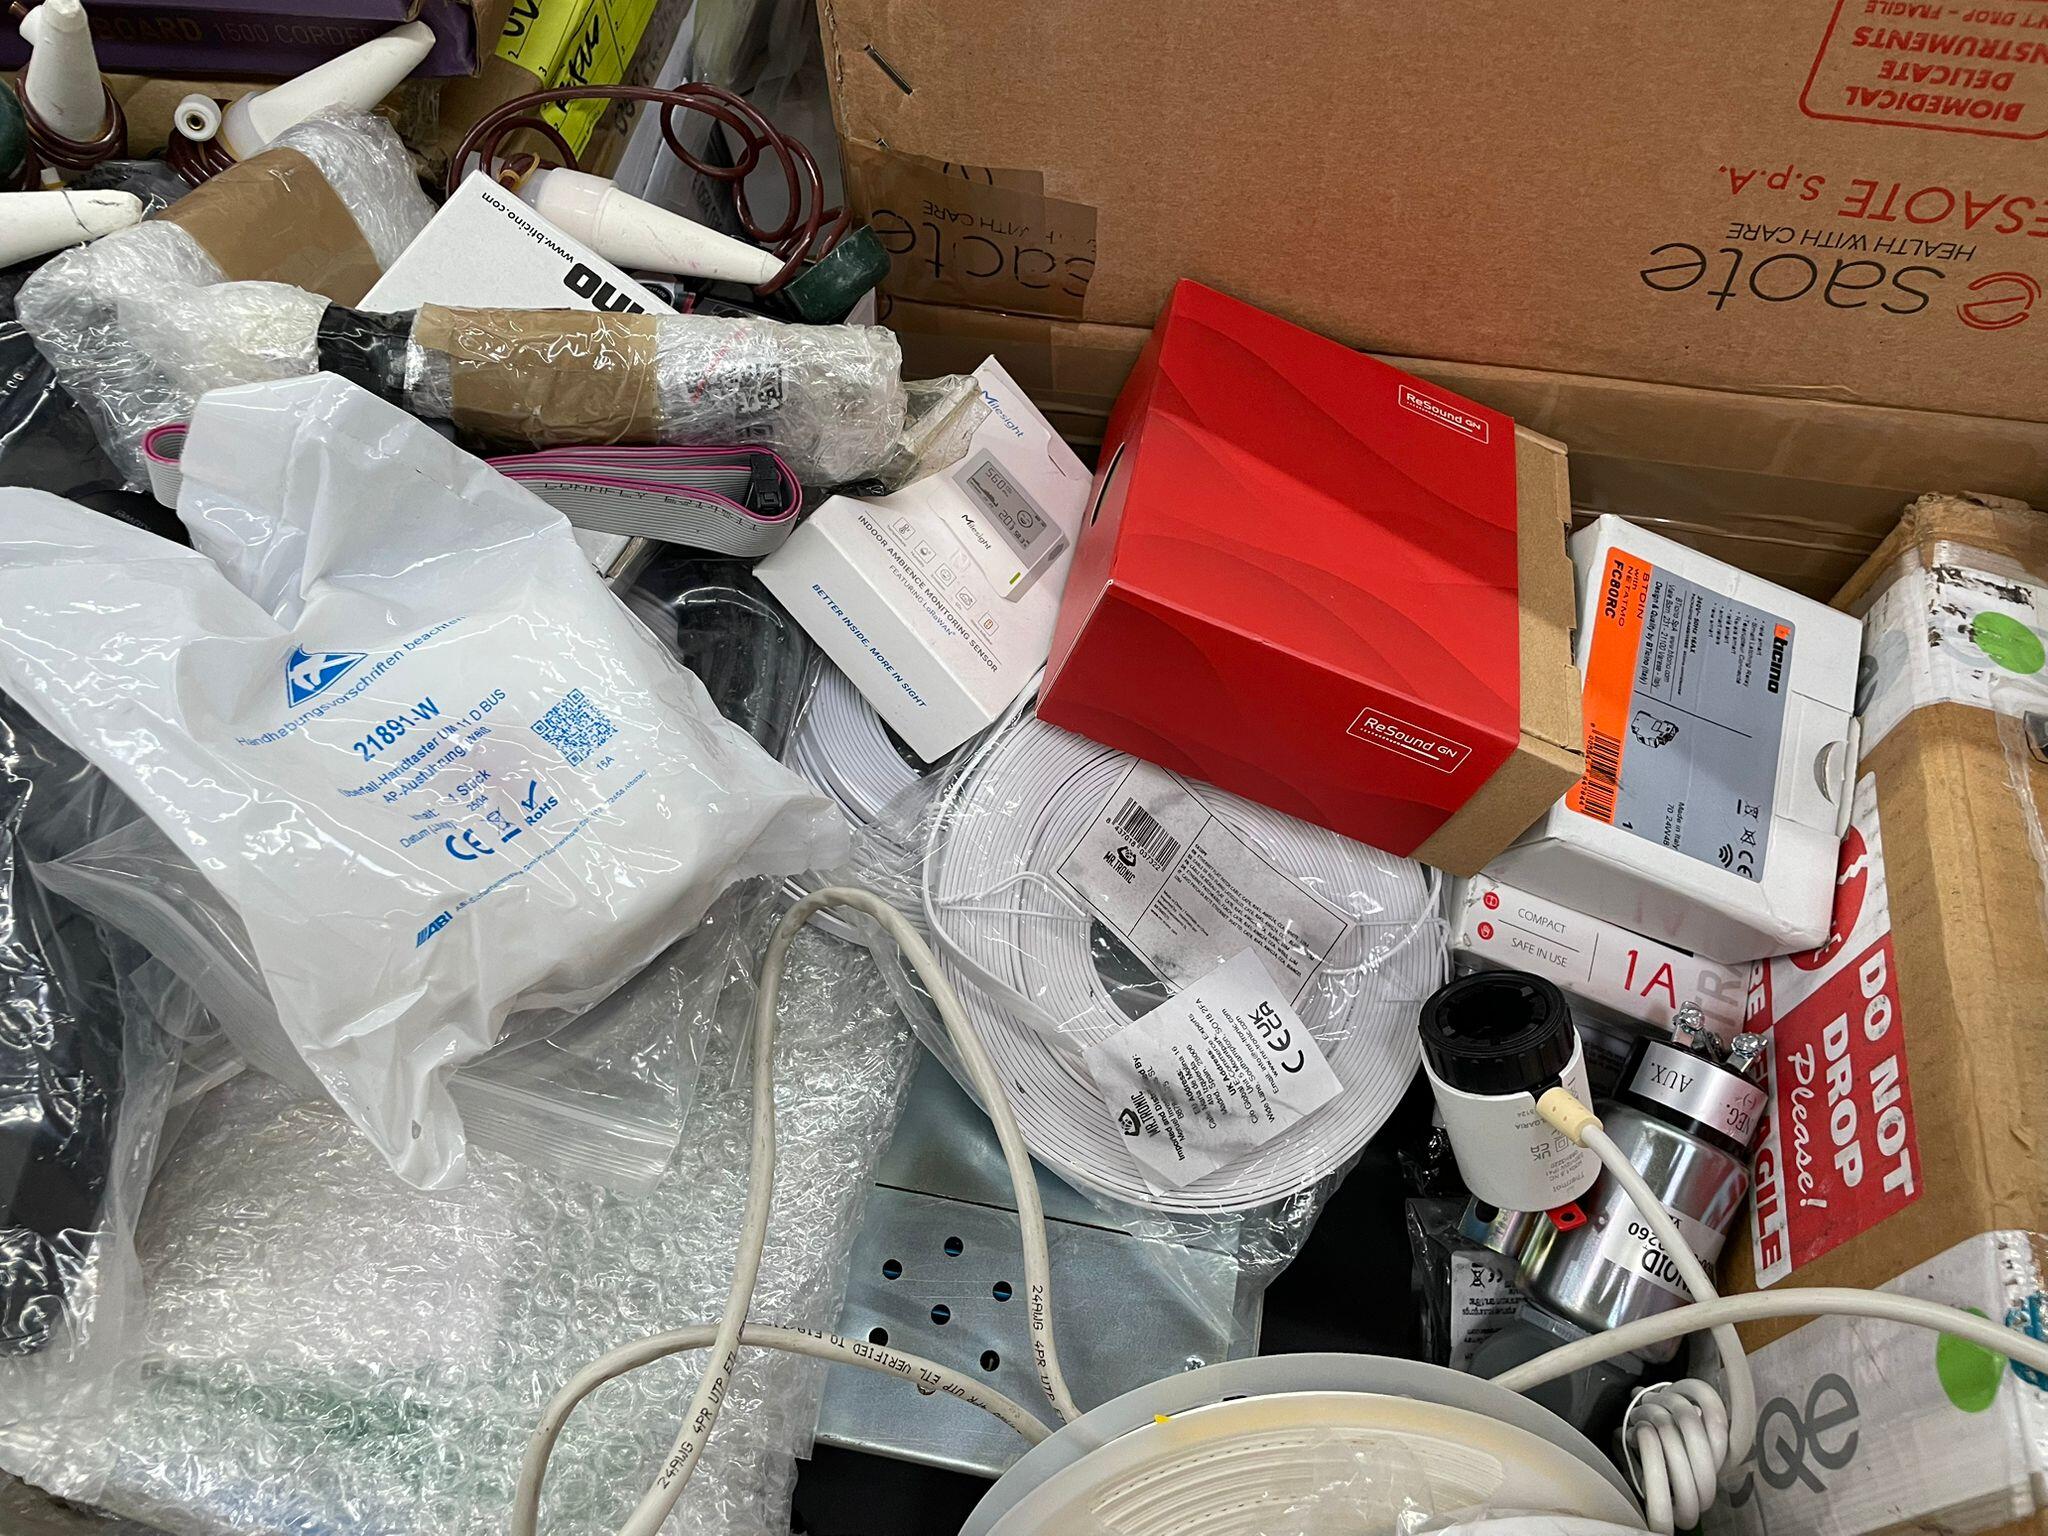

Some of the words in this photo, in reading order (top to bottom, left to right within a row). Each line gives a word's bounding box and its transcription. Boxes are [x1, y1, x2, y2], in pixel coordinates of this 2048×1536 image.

[1851, 26, 2048, 65] NSTRUMENTS
[1877, 60, 2017, 92] DELICATE
[1845, 85, 2027, 123] BIOMEDICAL
[480, 191, 576, 264] www.bticino.com
[1725, 221, 1796, 245] CARE
[1800, 228, 1870, 250] WITH
[1872, 235, 1978, 263] HEALTH
[981, 390, 1026, 438] Milesight
[1406, 392, 1463, 424] ReSound
[1465, 418, 1482, 431] GN
[958, 512, 995, 551] Milesight
[856, 513, 889, 548] INDOOR
[885, 545, 926, 590] AMBIENCE
[922, 587, 972, 641] MONITORING
[967, 638, 999, 673] SENSOR
[887, 563, 925, 604] FEATURING
[1617, 565, 1633, 627] NETATMO
[1650, 580, 1663, 604] Design
[811, 582, 845, 619] BETTER
[868, 643, 895, 675] MORE
[890, 667, 906, 686] IN
[900, 677, 929, 710] SIGHT
[468, 707, 483, 722] D
[478, 686, 506, 713] BUS
[351, 695, 441, 762] 21891-W
[1363, 717, 1436, 752] ReSound
[1437, 745, 1458, 758] GN
[524, 794, 560, 827] RoHS
[1101, 849, 1137, 885] MR.TRONIC
[1517, 907, 1567, 935] COMPACT
[1511, 936, 1536, 956] SAFE
[1536, 946, 1548, 961] IN
[1549, 951, 1568, 969] USE
[1624, 949, 1677, 1010] 1A
[1860, 948, 1893, 1042] DO
[1204, 1045, 1230, 1082] Address:
[1650, 1062, 1694, 1094] AUX.
[1174, 1067, 1196, 1102] Address:
[1224, 1081, 1238, 1096] UK
[1822, 1012, 1865, 1188] DROP
[1128, 1089, 1162, 1138] MR.TRONIC
[1157, 1110, 1170, 1126] and
[1787, 1042, 1828, 1209] Please!
[1869, 1054, 1915, 1197] NOT
[1163, 1125, 1187, 1161] Imported
[1031, 1282, 1044, 1330] 24AWG
[826, 1331, 847, 1349] TO
[850, 1340, 914, 1375] VERIFIED
[1032, 1339, 1046, 1368] 4PR
[915, 1365, 942, 1387] ETL
[940, 1378, 967, 1399] UTP
[655, 1438, 696, 1492] 24AWG
[689, 1406, 714, 1435] 4PR
[704, 1375, 731, 1405] UTP
